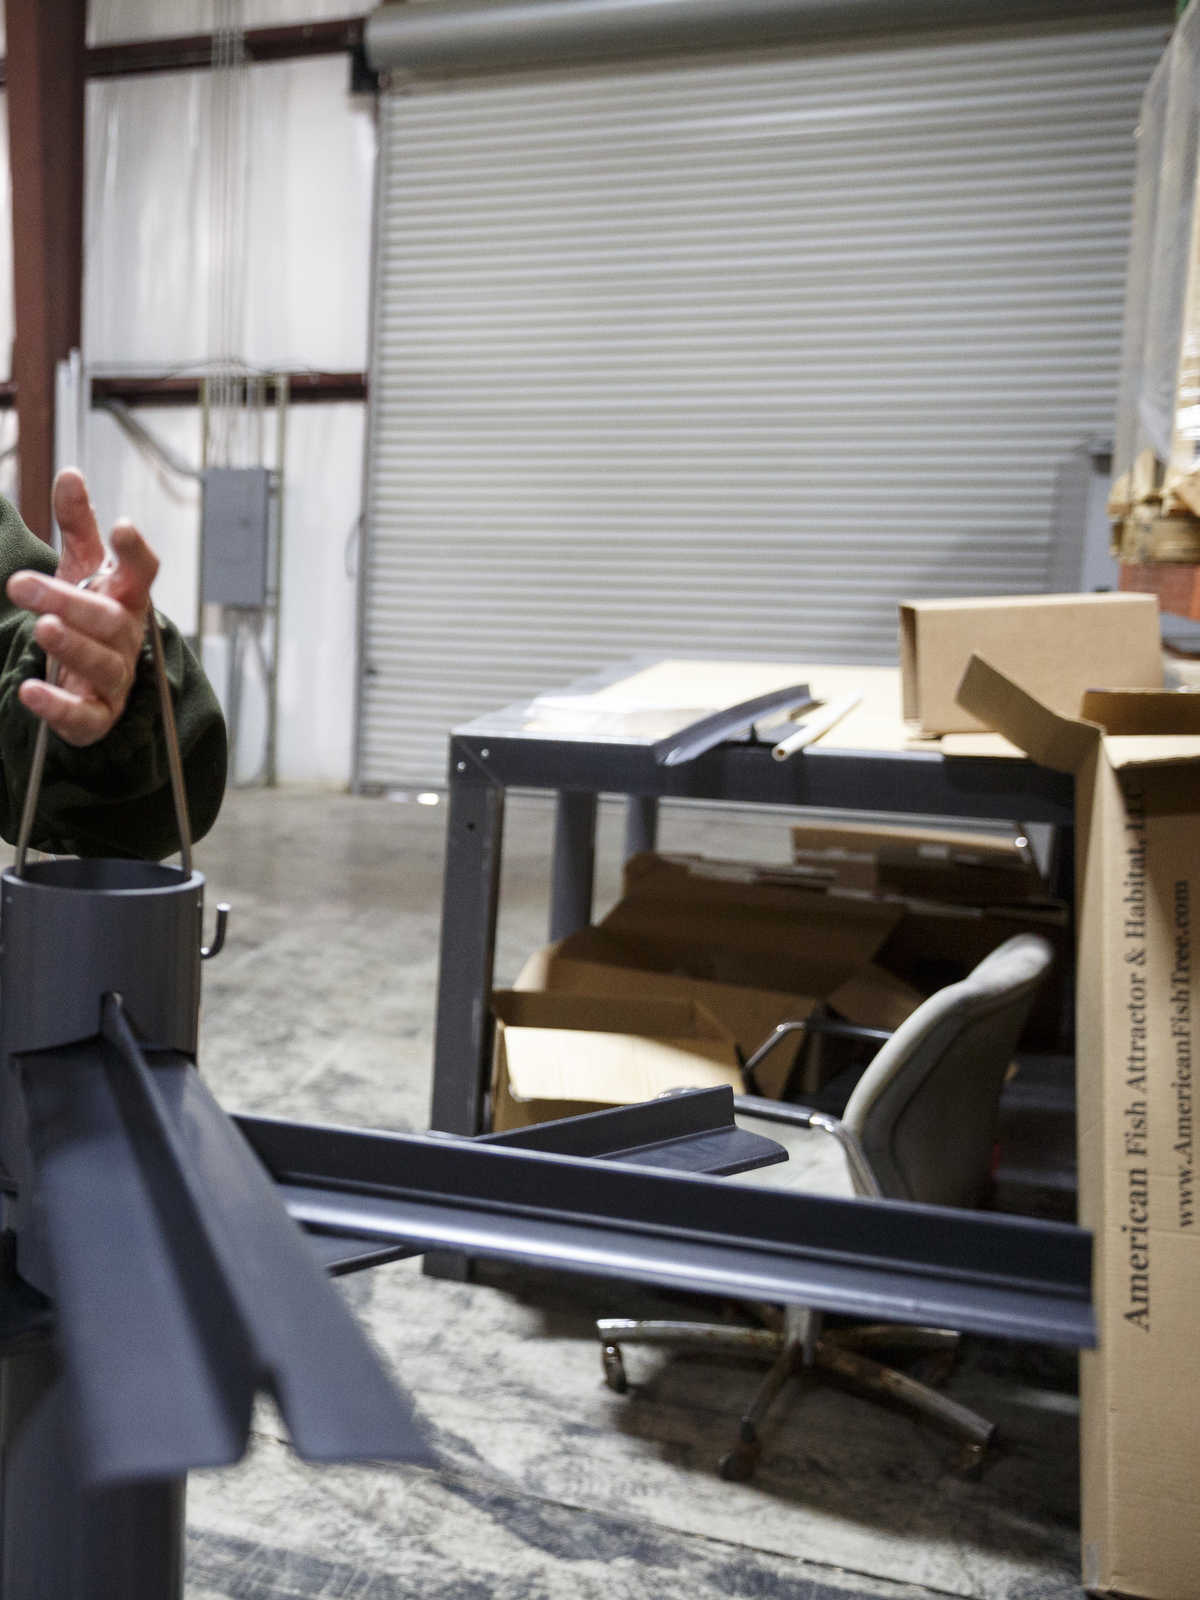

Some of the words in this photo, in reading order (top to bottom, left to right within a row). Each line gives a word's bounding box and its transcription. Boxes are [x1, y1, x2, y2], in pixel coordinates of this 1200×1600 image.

[1124, 839, 1146, 938] Habitat,
[1124, 949, 1146, 966] &
[1125, 972, 1147, 1094] Attractor
[1170, 879, 1195, 1228] www.AmericanFishTree.com
[1124, 1100, 1148, 1157] Fish
[1120, 1167, 1150, 1333] American
